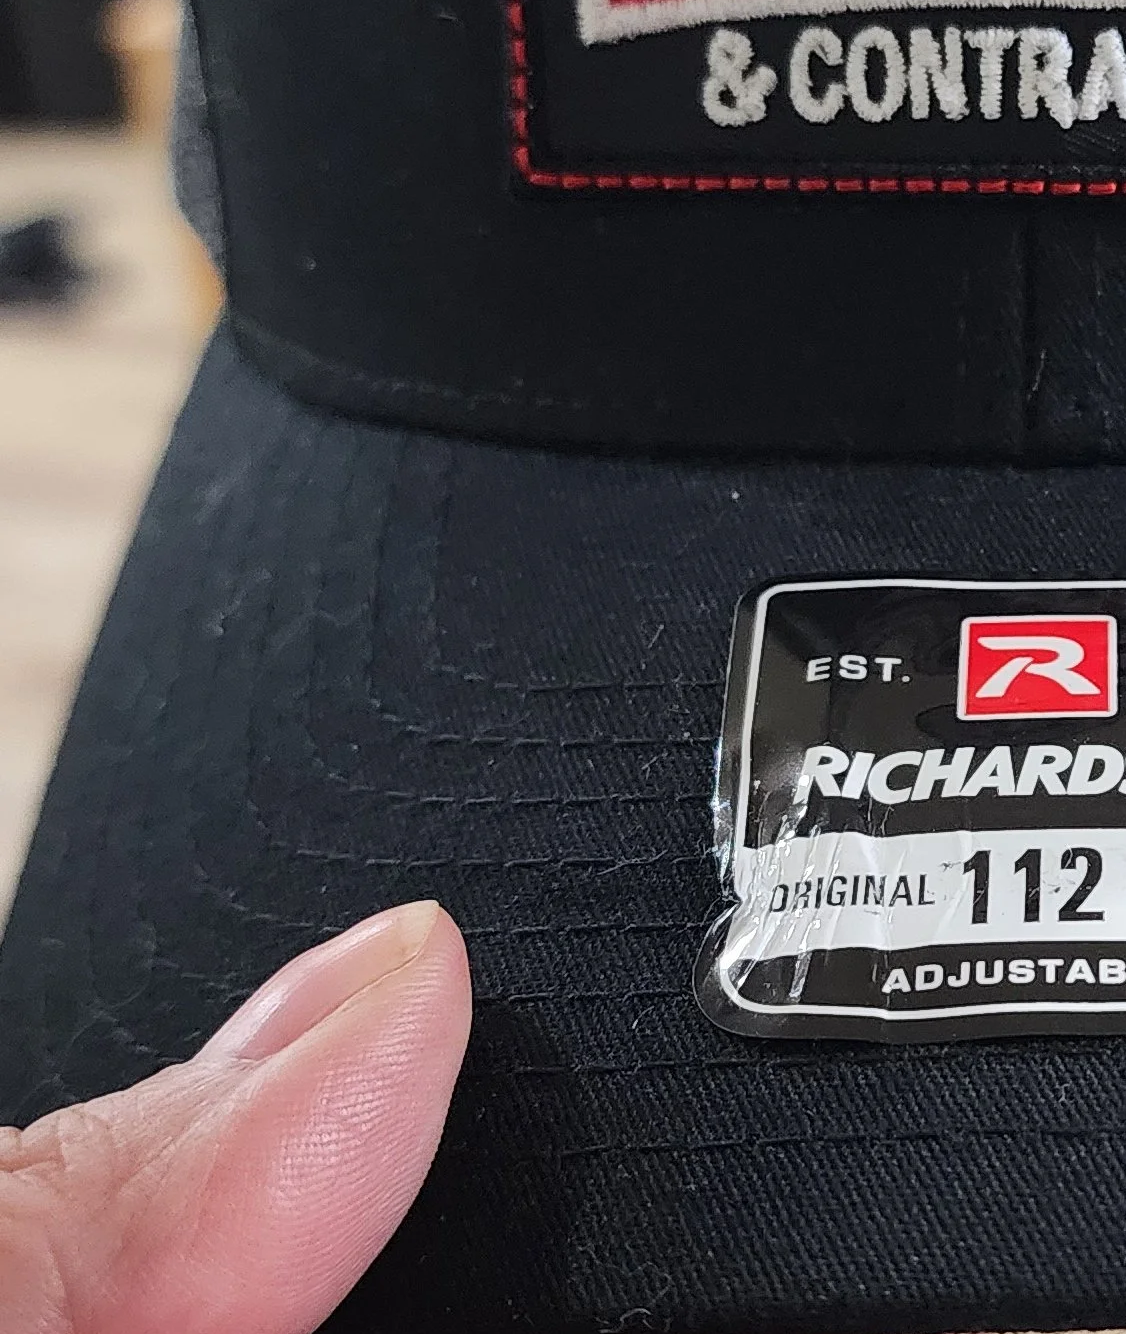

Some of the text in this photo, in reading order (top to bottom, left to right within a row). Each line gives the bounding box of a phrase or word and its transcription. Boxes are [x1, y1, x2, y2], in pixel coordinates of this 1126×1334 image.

[702, 27, 777, 127] &
[806, 656, 911, 683] EST.
[769, 872, 936, 913] ORIGINAL
[962, 846, 1106, 925] 112
